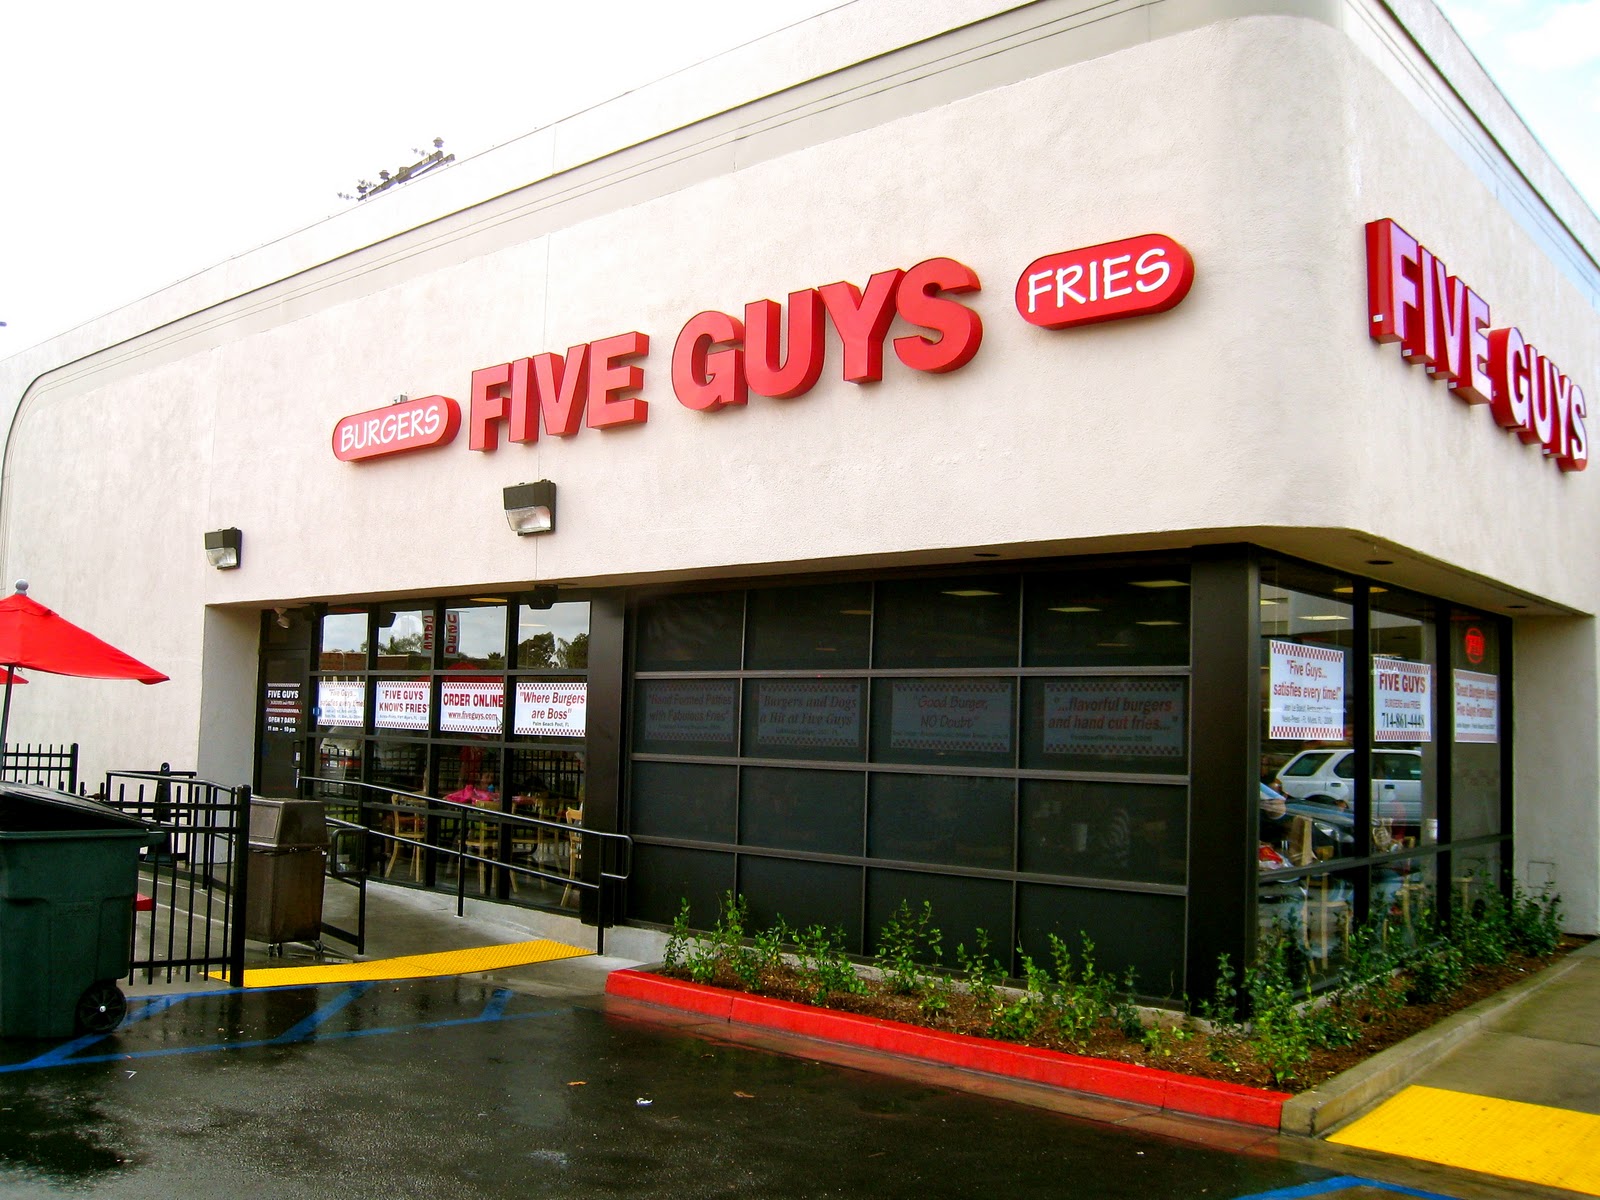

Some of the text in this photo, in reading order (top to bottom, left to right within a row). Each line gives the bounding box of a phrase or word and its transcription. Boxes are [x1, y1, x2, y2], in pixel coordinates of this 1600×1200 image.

[1028, 248, 1170, 313] FRIES
[1365, 218, 1588, 472] FIVE GUYS
[469, 257, 983, 452] FIVE GUYS
[341, 405, 440, 452] BURGERS
[1379, 674, 1426, 693] FIVE GUYS
[268, 690, 299, 699] FIVE GUYS
[403, 691, 424, 700] GUYS
[552, 692, 585, 706] Burgers
[1274, 682, 1302, 697] satisfies
[1303, 687, 1322, 702] every
[443, 693, 504, 707] ORDER ONLINE
[830, 696, 857, 711] Dogs
[1122, 696, 1172, 715] burgers
[379, 702, 404, 713] KNOWS
[531, 710, 545, 719] are
[448, 711, 497, 720] www.fiveguys.com
[921, 715, 938, 728] NO
[1048, 716, 1072, 729] and
[1074, 716, 1105, 729] hand
[1107, 717, 1129, 729] cut
